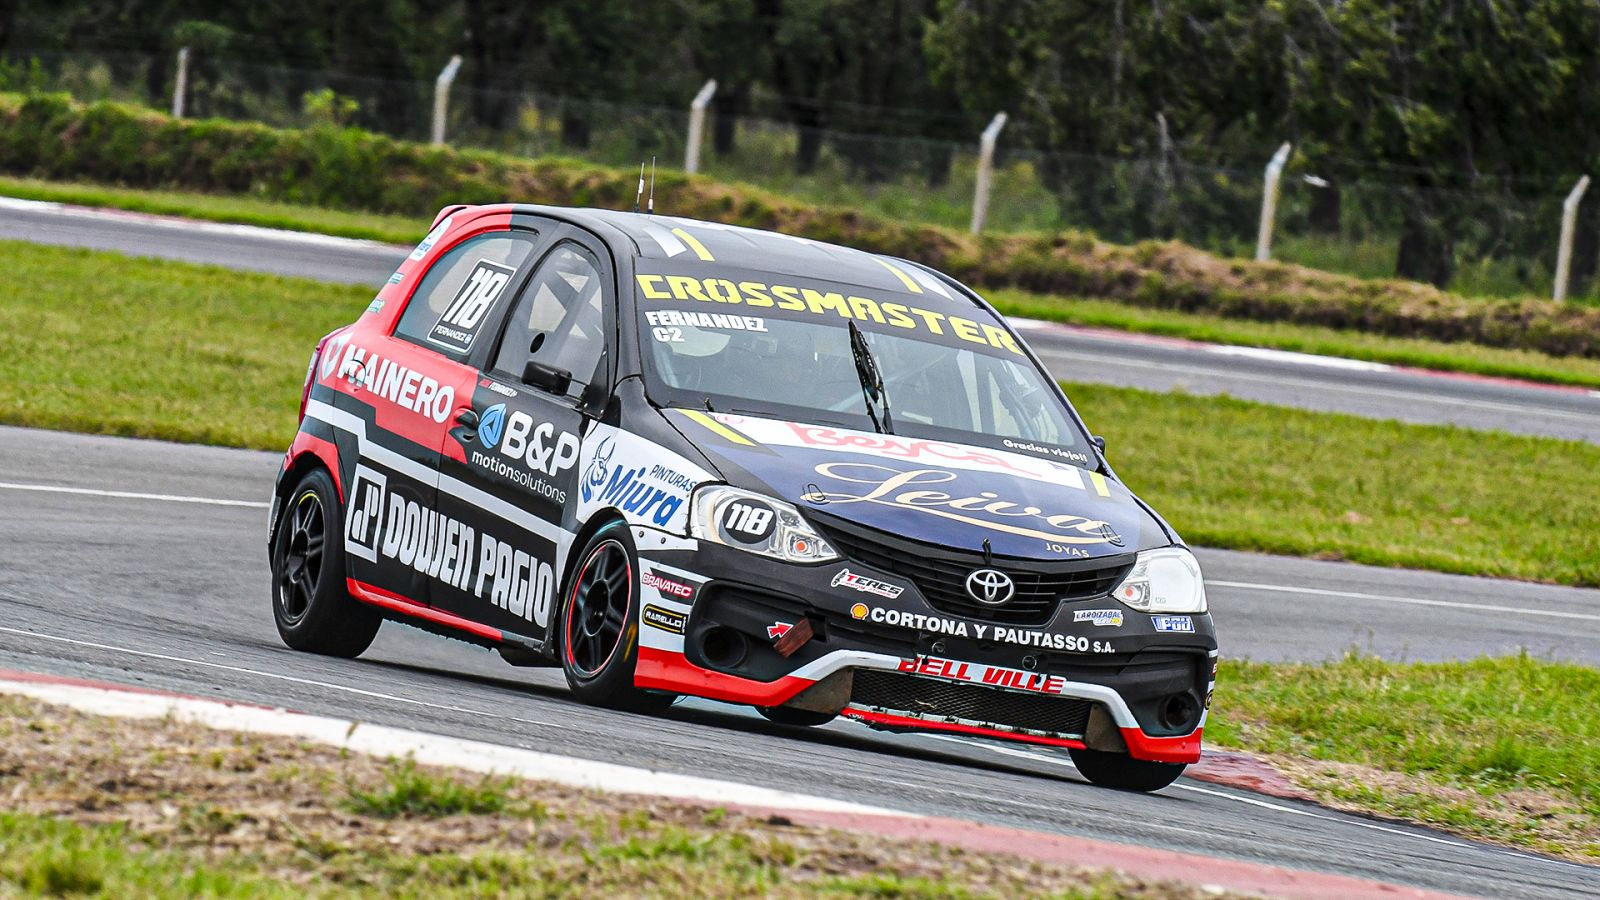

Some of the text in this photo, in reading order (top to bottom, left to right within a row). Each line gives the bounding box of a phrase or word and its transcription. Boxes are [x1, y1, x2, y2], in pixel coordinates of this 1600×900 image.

[442, 267, 510, 329] 118
[635, 274, 1025, 356] CROSSMASTER
[434, 324, 468, 342] FERNANDEZ
[645, 311, 769, 332] FERNANDEZ
[652, 327, 685, 342] C2
[336, 344, 455, 424] MAINERO
[500, 410, 580, 477] B&P
[1002, 439, 1050, 454] Gracias
[472, 450, 567, 504] motionsolutions
[597, 464, 684, 527] Miura
[650, 464, 697, 492] PINTURAS
[725, 503, 774, 535] 118
[800, 462, 1122, 544] Leiva
[382, 491, 554, 629] DOWEN PAGIO
[1045, 541, 1090, 558] JOYAS
[641, 573, 693, 598] BRAVATEC
[846, 574, 900, 595] TERES
[871, 607, 1116, 653] CORTONA Y PAUTASSO S.A.
[897, 655, 1065, 694] BELL VILLE
